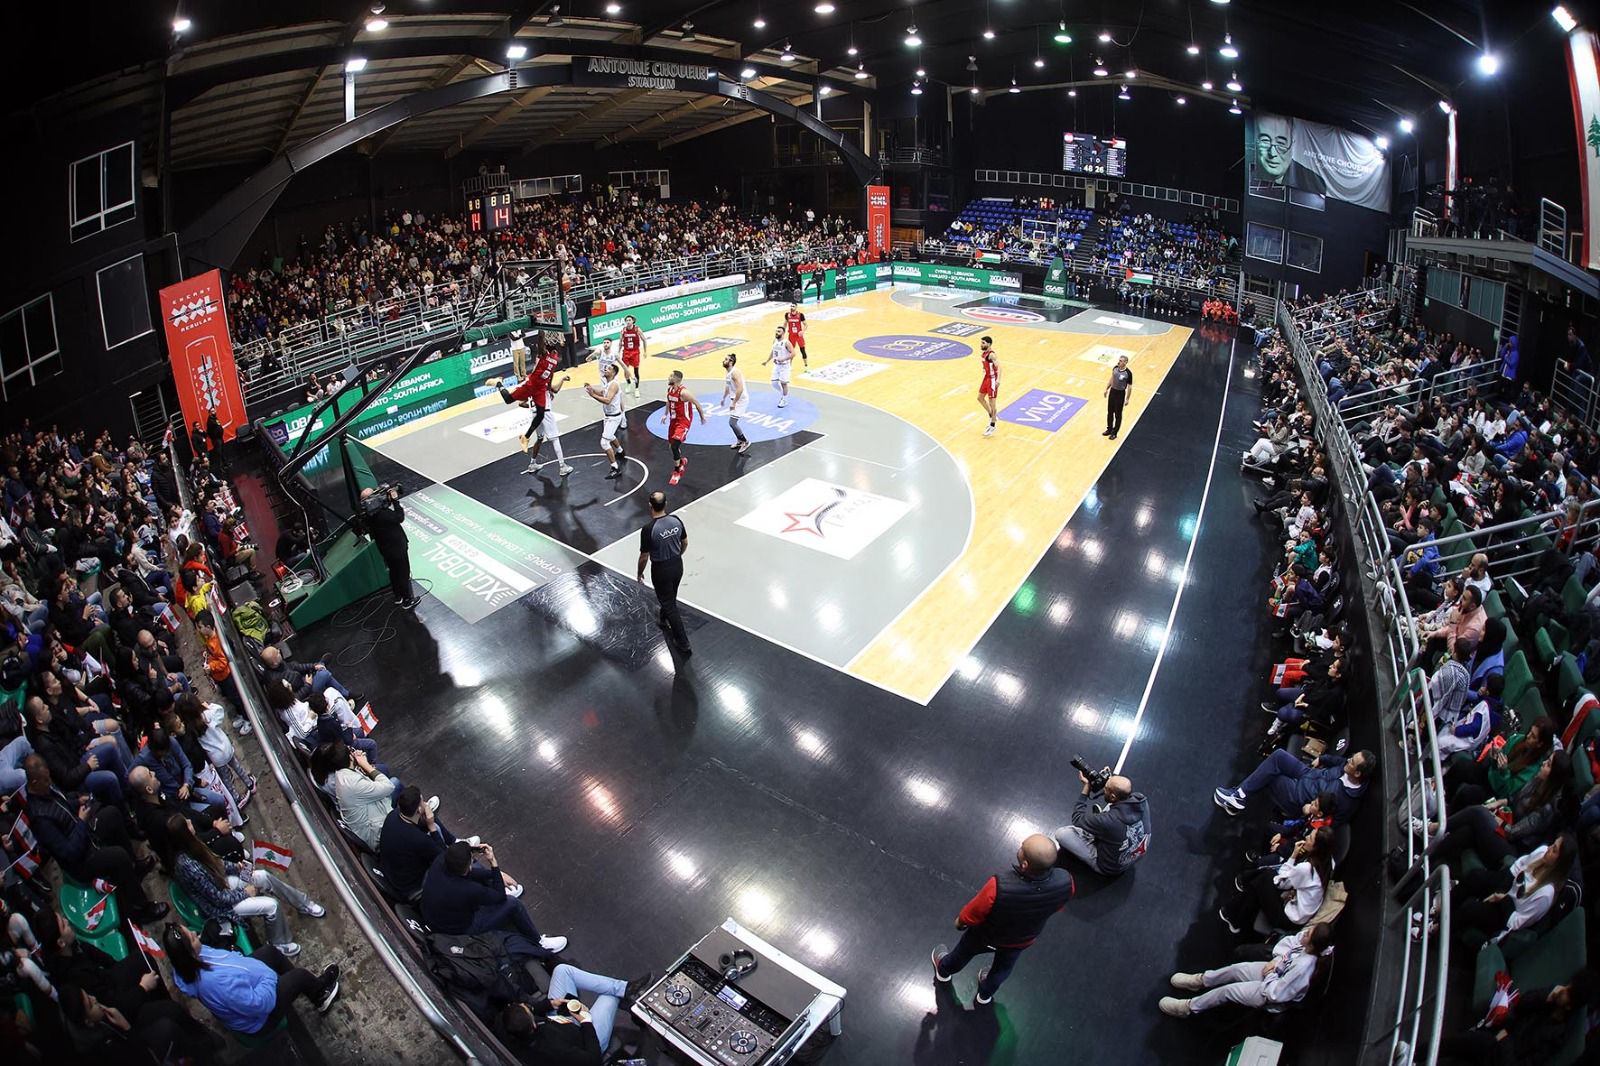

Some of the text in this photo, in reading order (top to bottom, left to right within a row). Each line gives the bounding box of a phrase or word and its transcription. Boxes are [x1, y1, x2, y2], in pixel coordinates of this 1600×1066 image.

[588, 58, 709, 80] ANTOINE CHOUEIRI
[628, 76, 676, 90] STADIUM
[1083, 164, 1104, 174] 48 26
[495, 207, 510, 228] 14
[171, 295, 218, 327] XXL
[660, 302, 684, 313] CYPRUS
[687, 296, 713, 307] LEBANON
[683, 307, 703, 317] SOUTH
[702, 303, 721, 312] AFRICA
[472, 347, 513, 366] XGLOBA
[393, 386, 418, 400] SOUTH
[419, 377, 445, 392] AFRICA
[396, 372, 431, 390] LEBANON
[1016, 394, 1066, 423] vivo
[660, 527, 680, 537] vivo
[422, 541, 510, 602] XGLOBAL
[525, 553, 562, 575] CYPRUS
